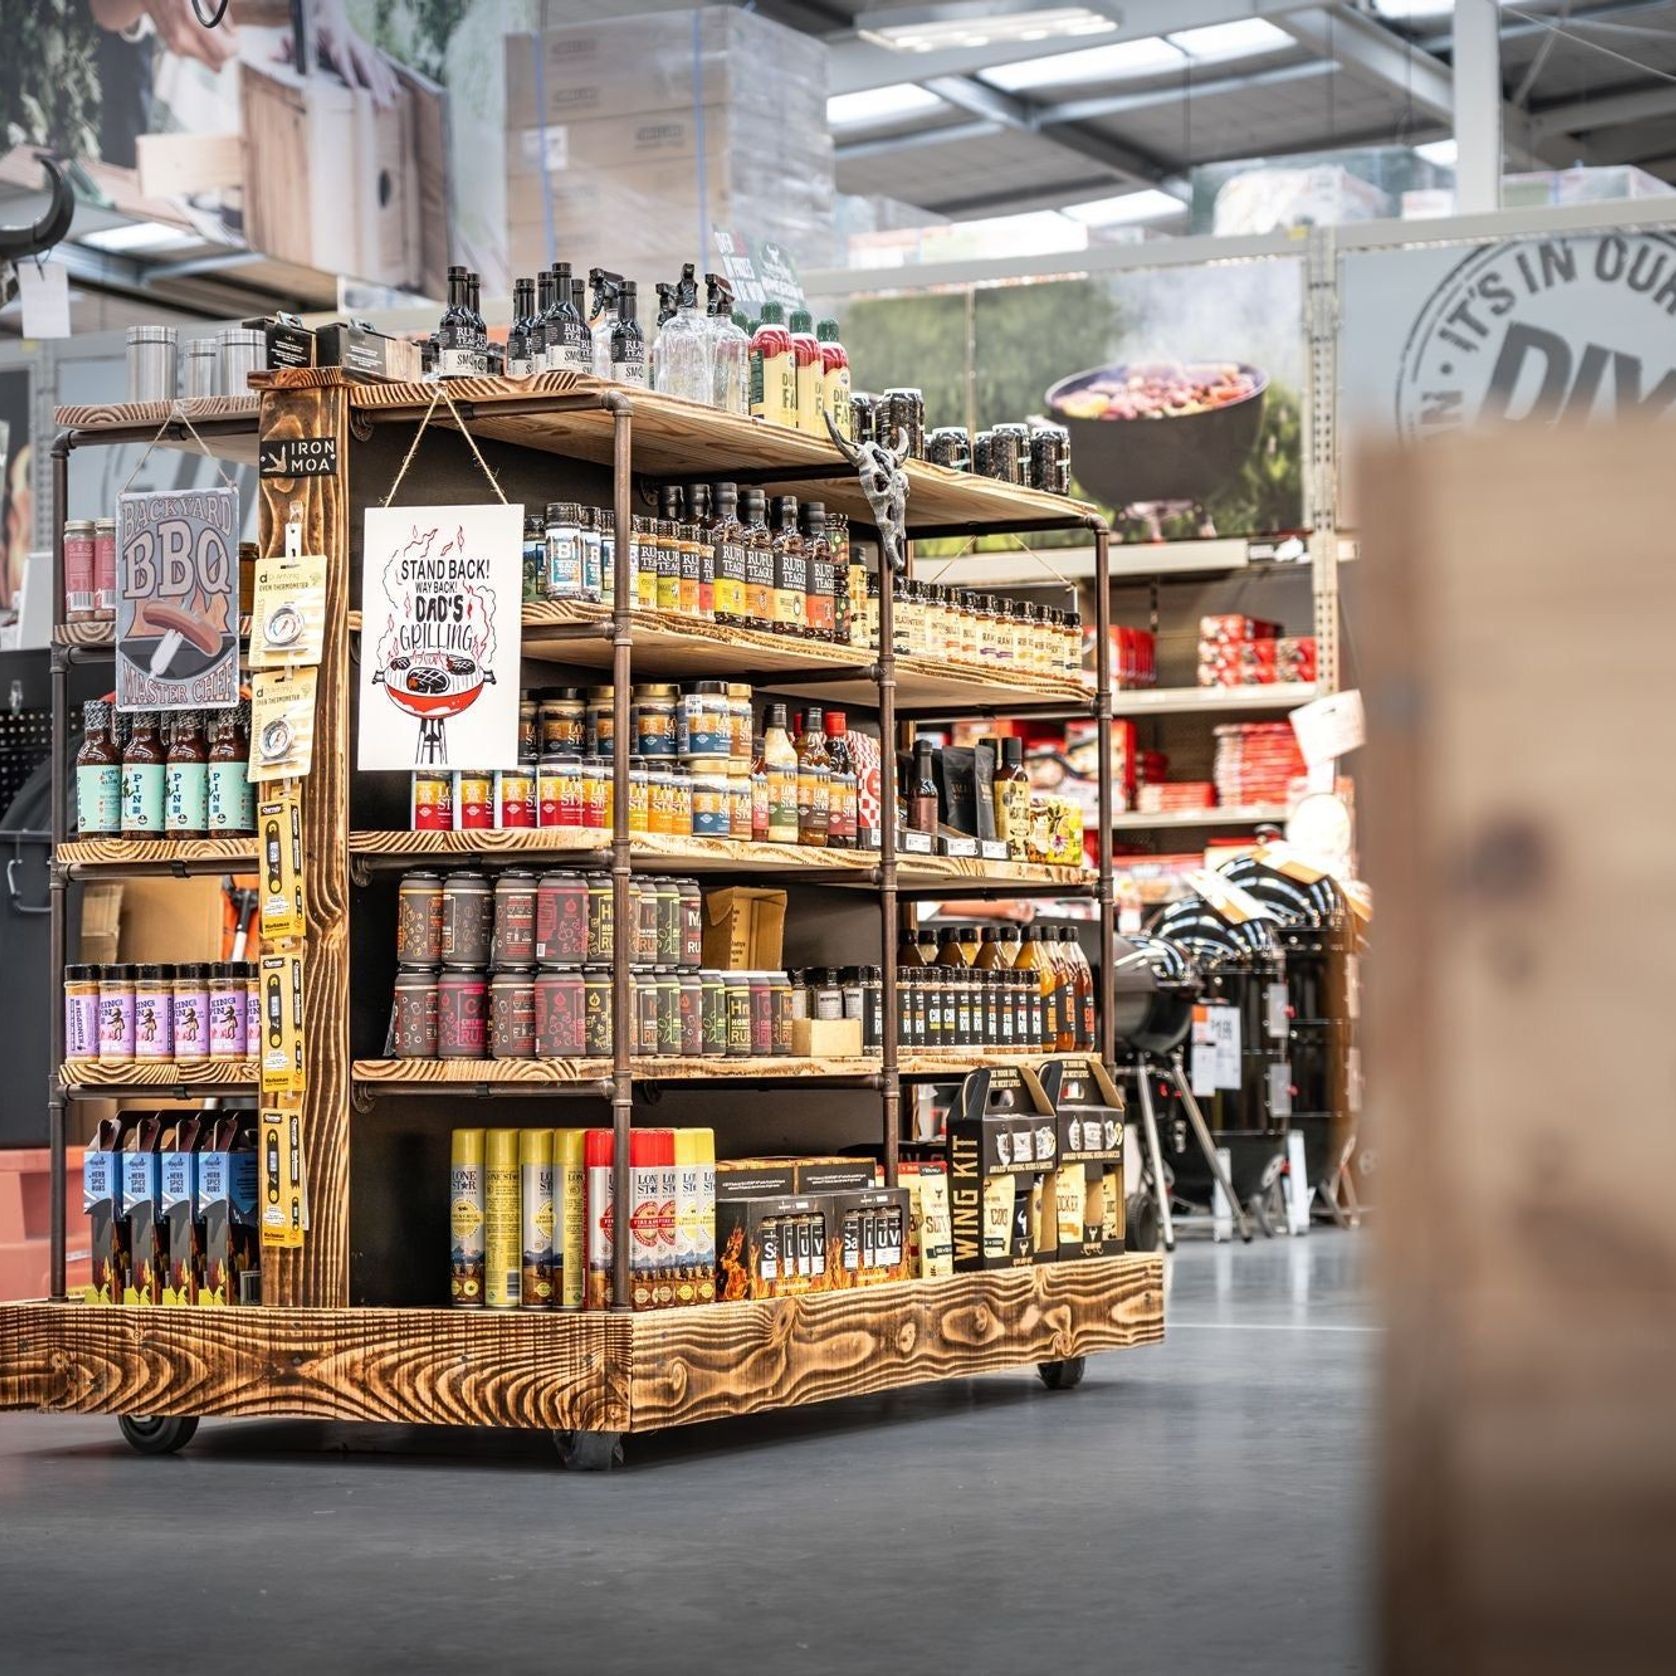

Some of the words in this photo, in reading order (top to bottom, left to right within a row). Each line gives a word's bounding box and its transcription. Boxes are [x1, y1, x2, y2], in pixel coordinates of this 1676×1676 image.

[1438, 271, 1516, 353] IT'S
[1516, 238, 1578, 294] IN
[291, 441, 335, 455] IRON
[291, 459, 330, 472] MOA
[122, 496, 232, 547] BACKYARD
[123, 519, 232, 600] BBQ
[401, 560, 445, 580] STAND
[449, 559, 491, 580] BACK!
[415, 581, 433, 594] WAY
[434, 581, 458, 594] BACK!
[416, 595, 464, 623] DAD'S
[400, 622, 474, 651] GRILLING
[122, 658, 188, 705] MASTER
[192, 656, 232, 702] CHEF
[953, 1135, 979, 1178] KIT
[953, 1189, 979, 1261] WING
